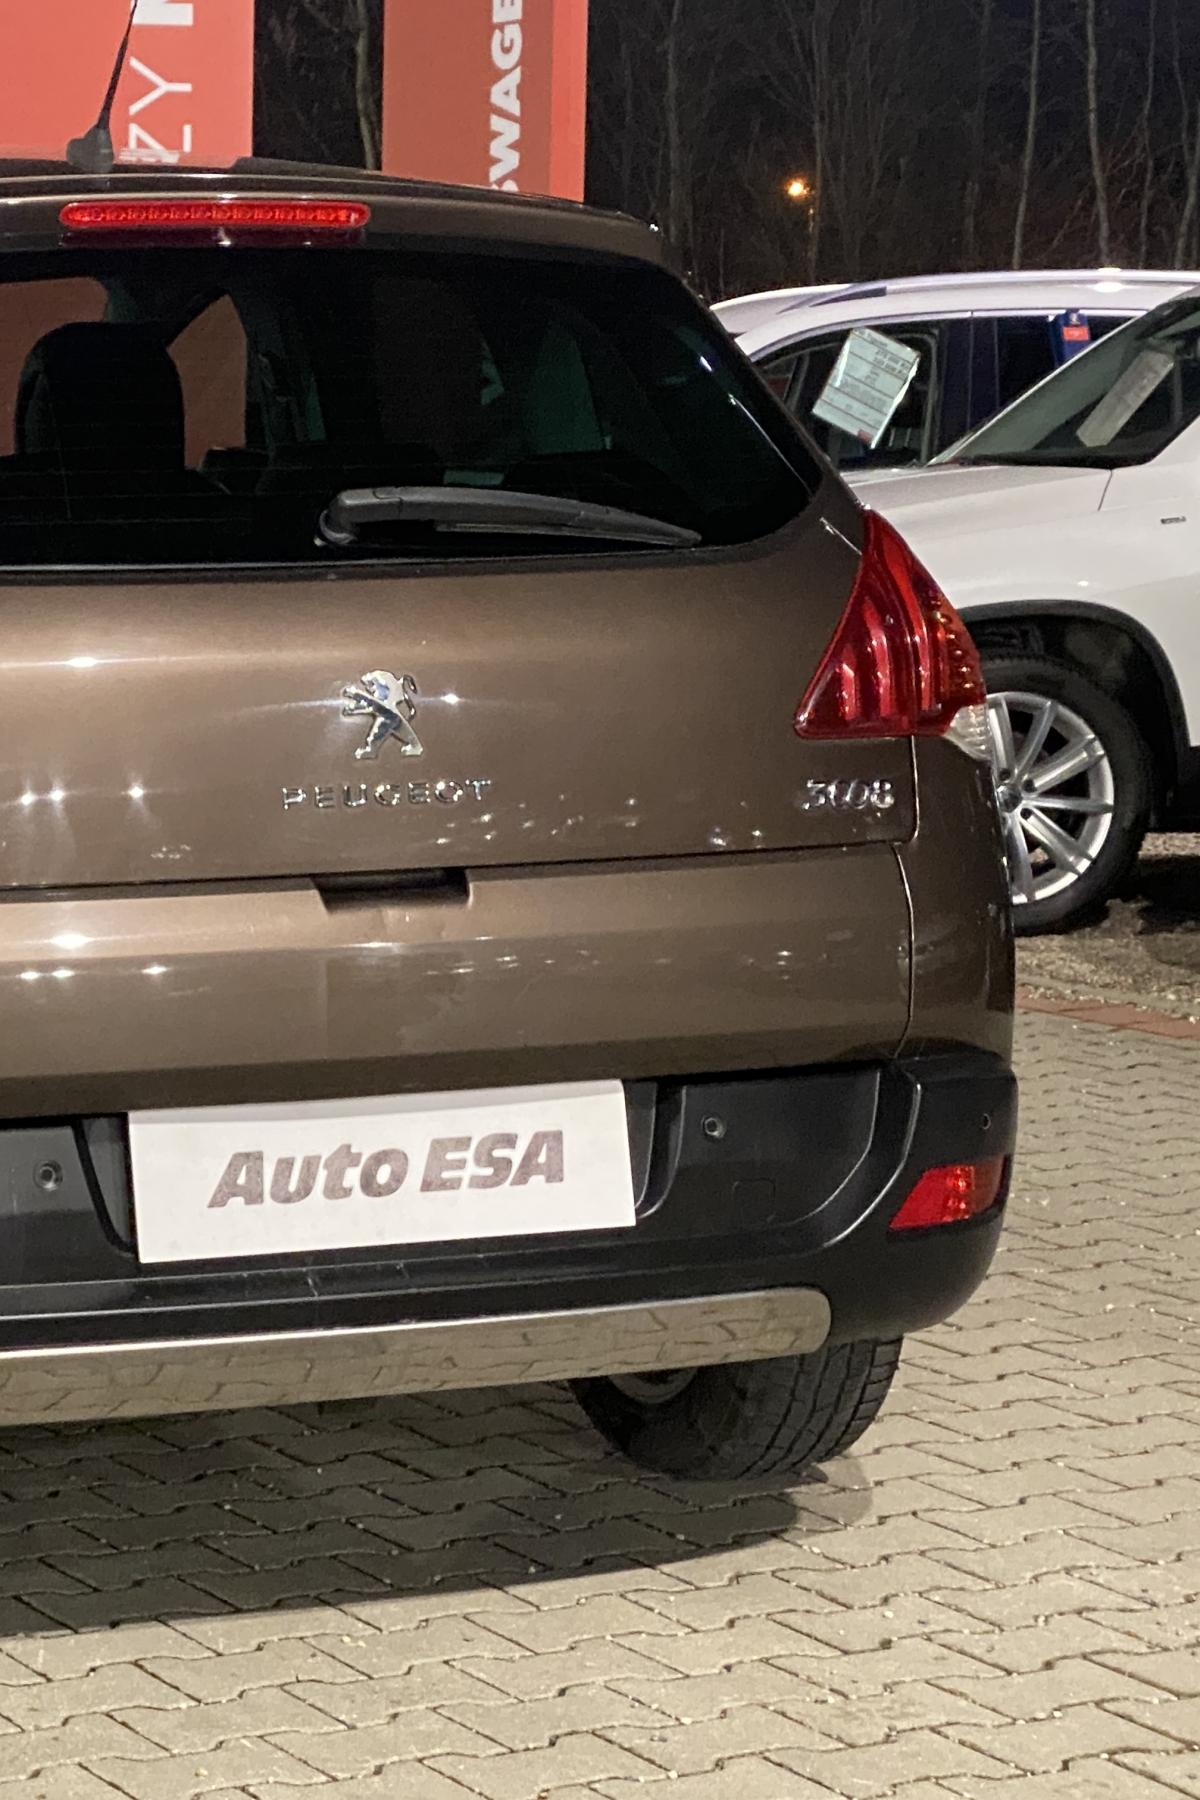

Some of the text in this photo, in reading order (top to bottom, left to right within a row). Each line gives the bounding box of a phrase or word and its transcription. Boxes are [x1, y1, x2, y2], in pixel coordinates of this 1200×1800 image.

[281, 777, 492, 810] PEUGEOT
[802, 777, 895, 809] 3008
[207, 1129, 564, 1209] Auto ESA
